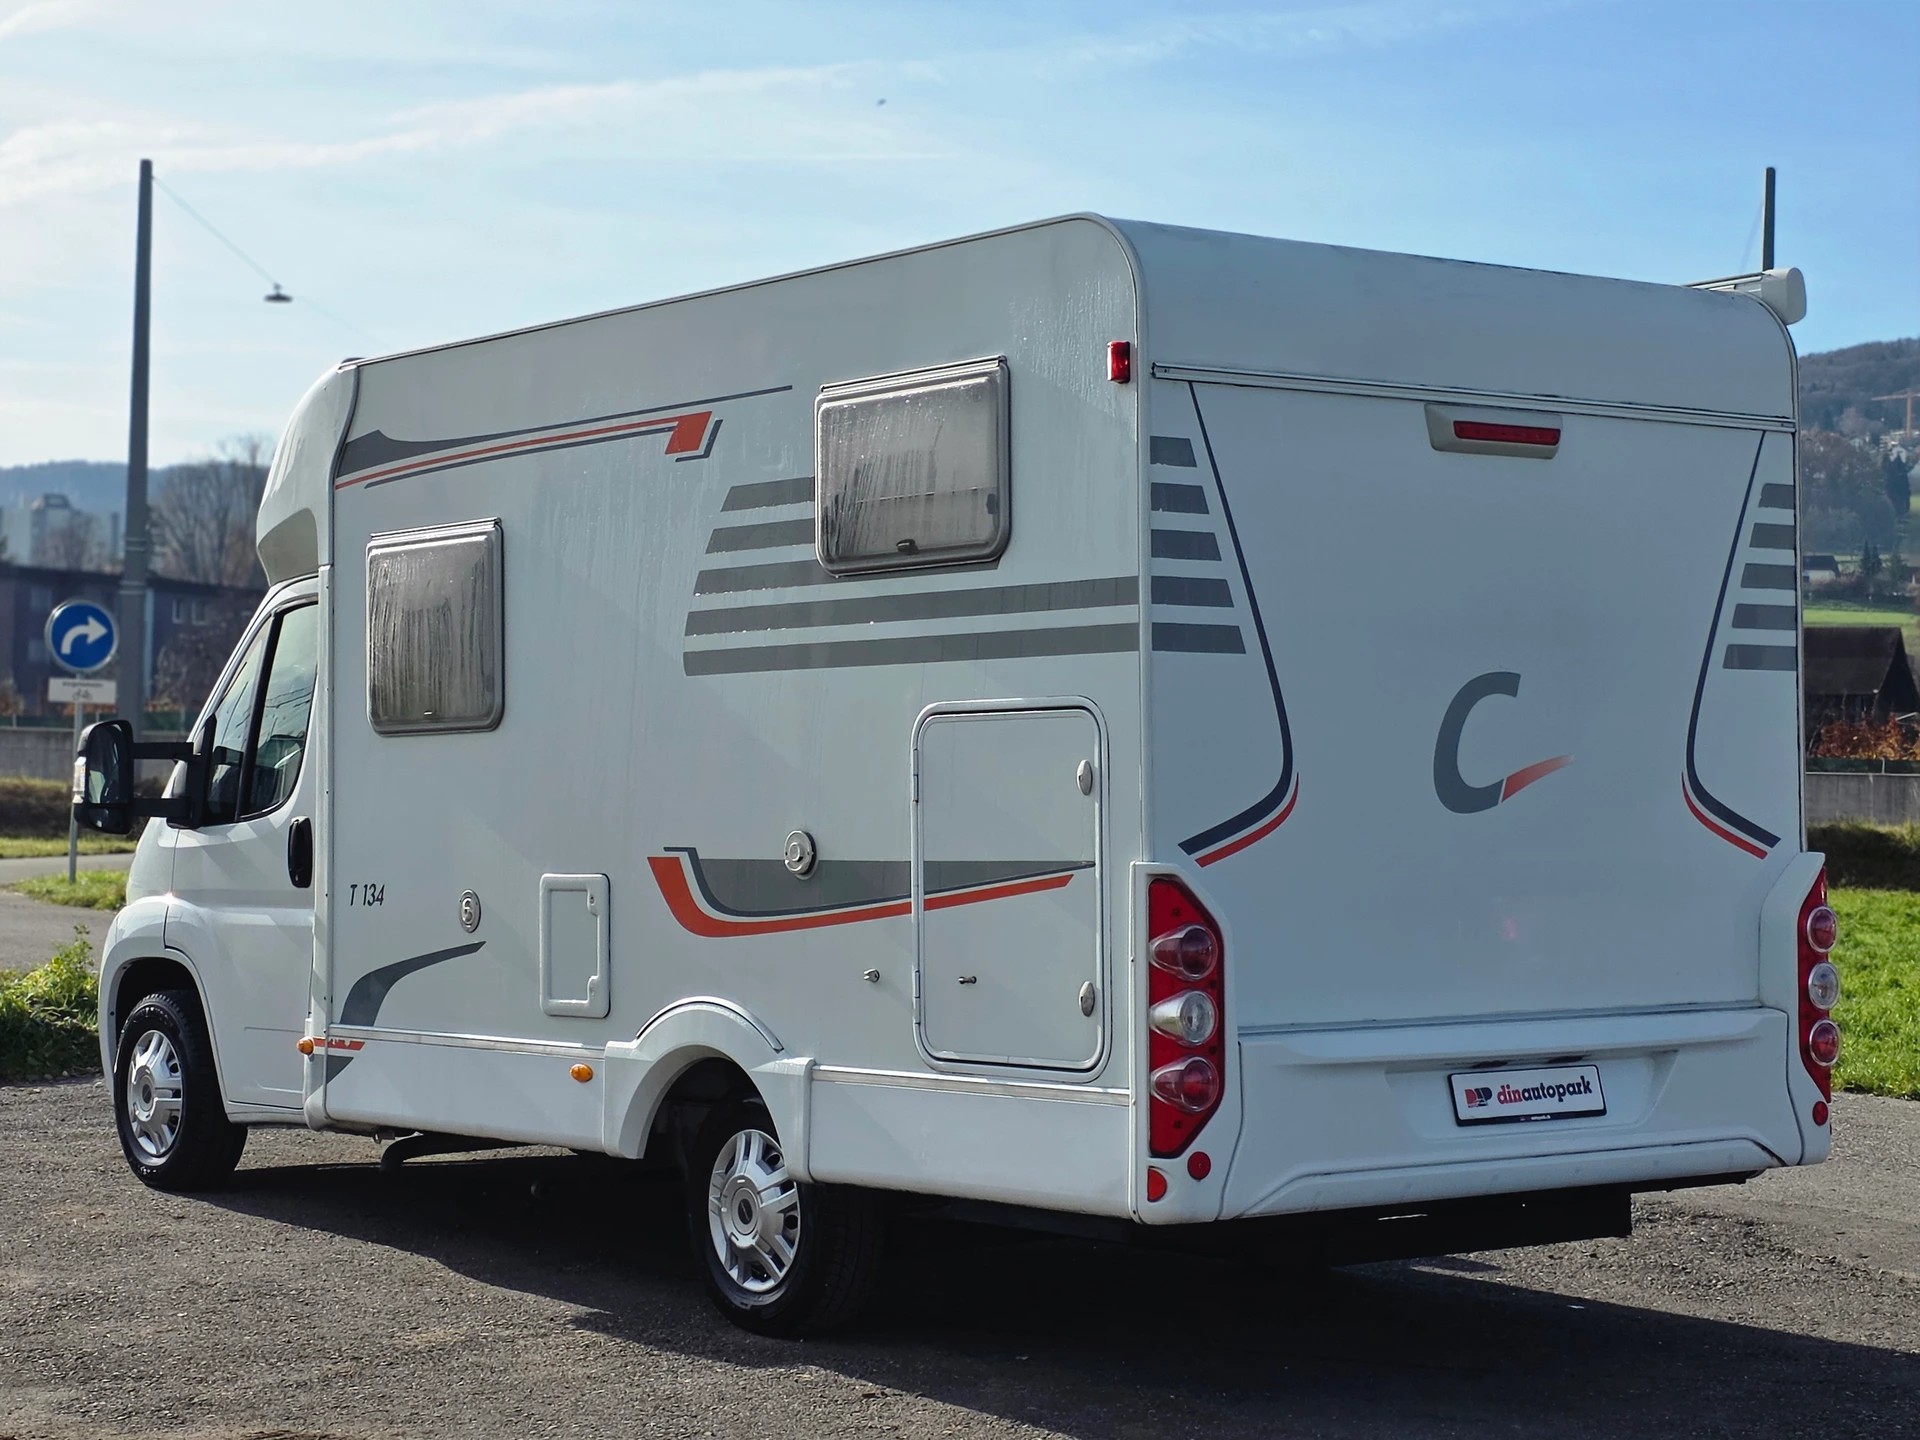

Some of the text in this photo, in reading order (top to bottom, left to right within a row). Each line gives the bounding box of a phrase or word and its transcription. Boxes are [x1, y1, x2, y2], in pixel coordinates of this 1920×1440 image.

[350, 883, 385, 907] T 134
[1496, 1075, 1593, 1105] dinautopark
